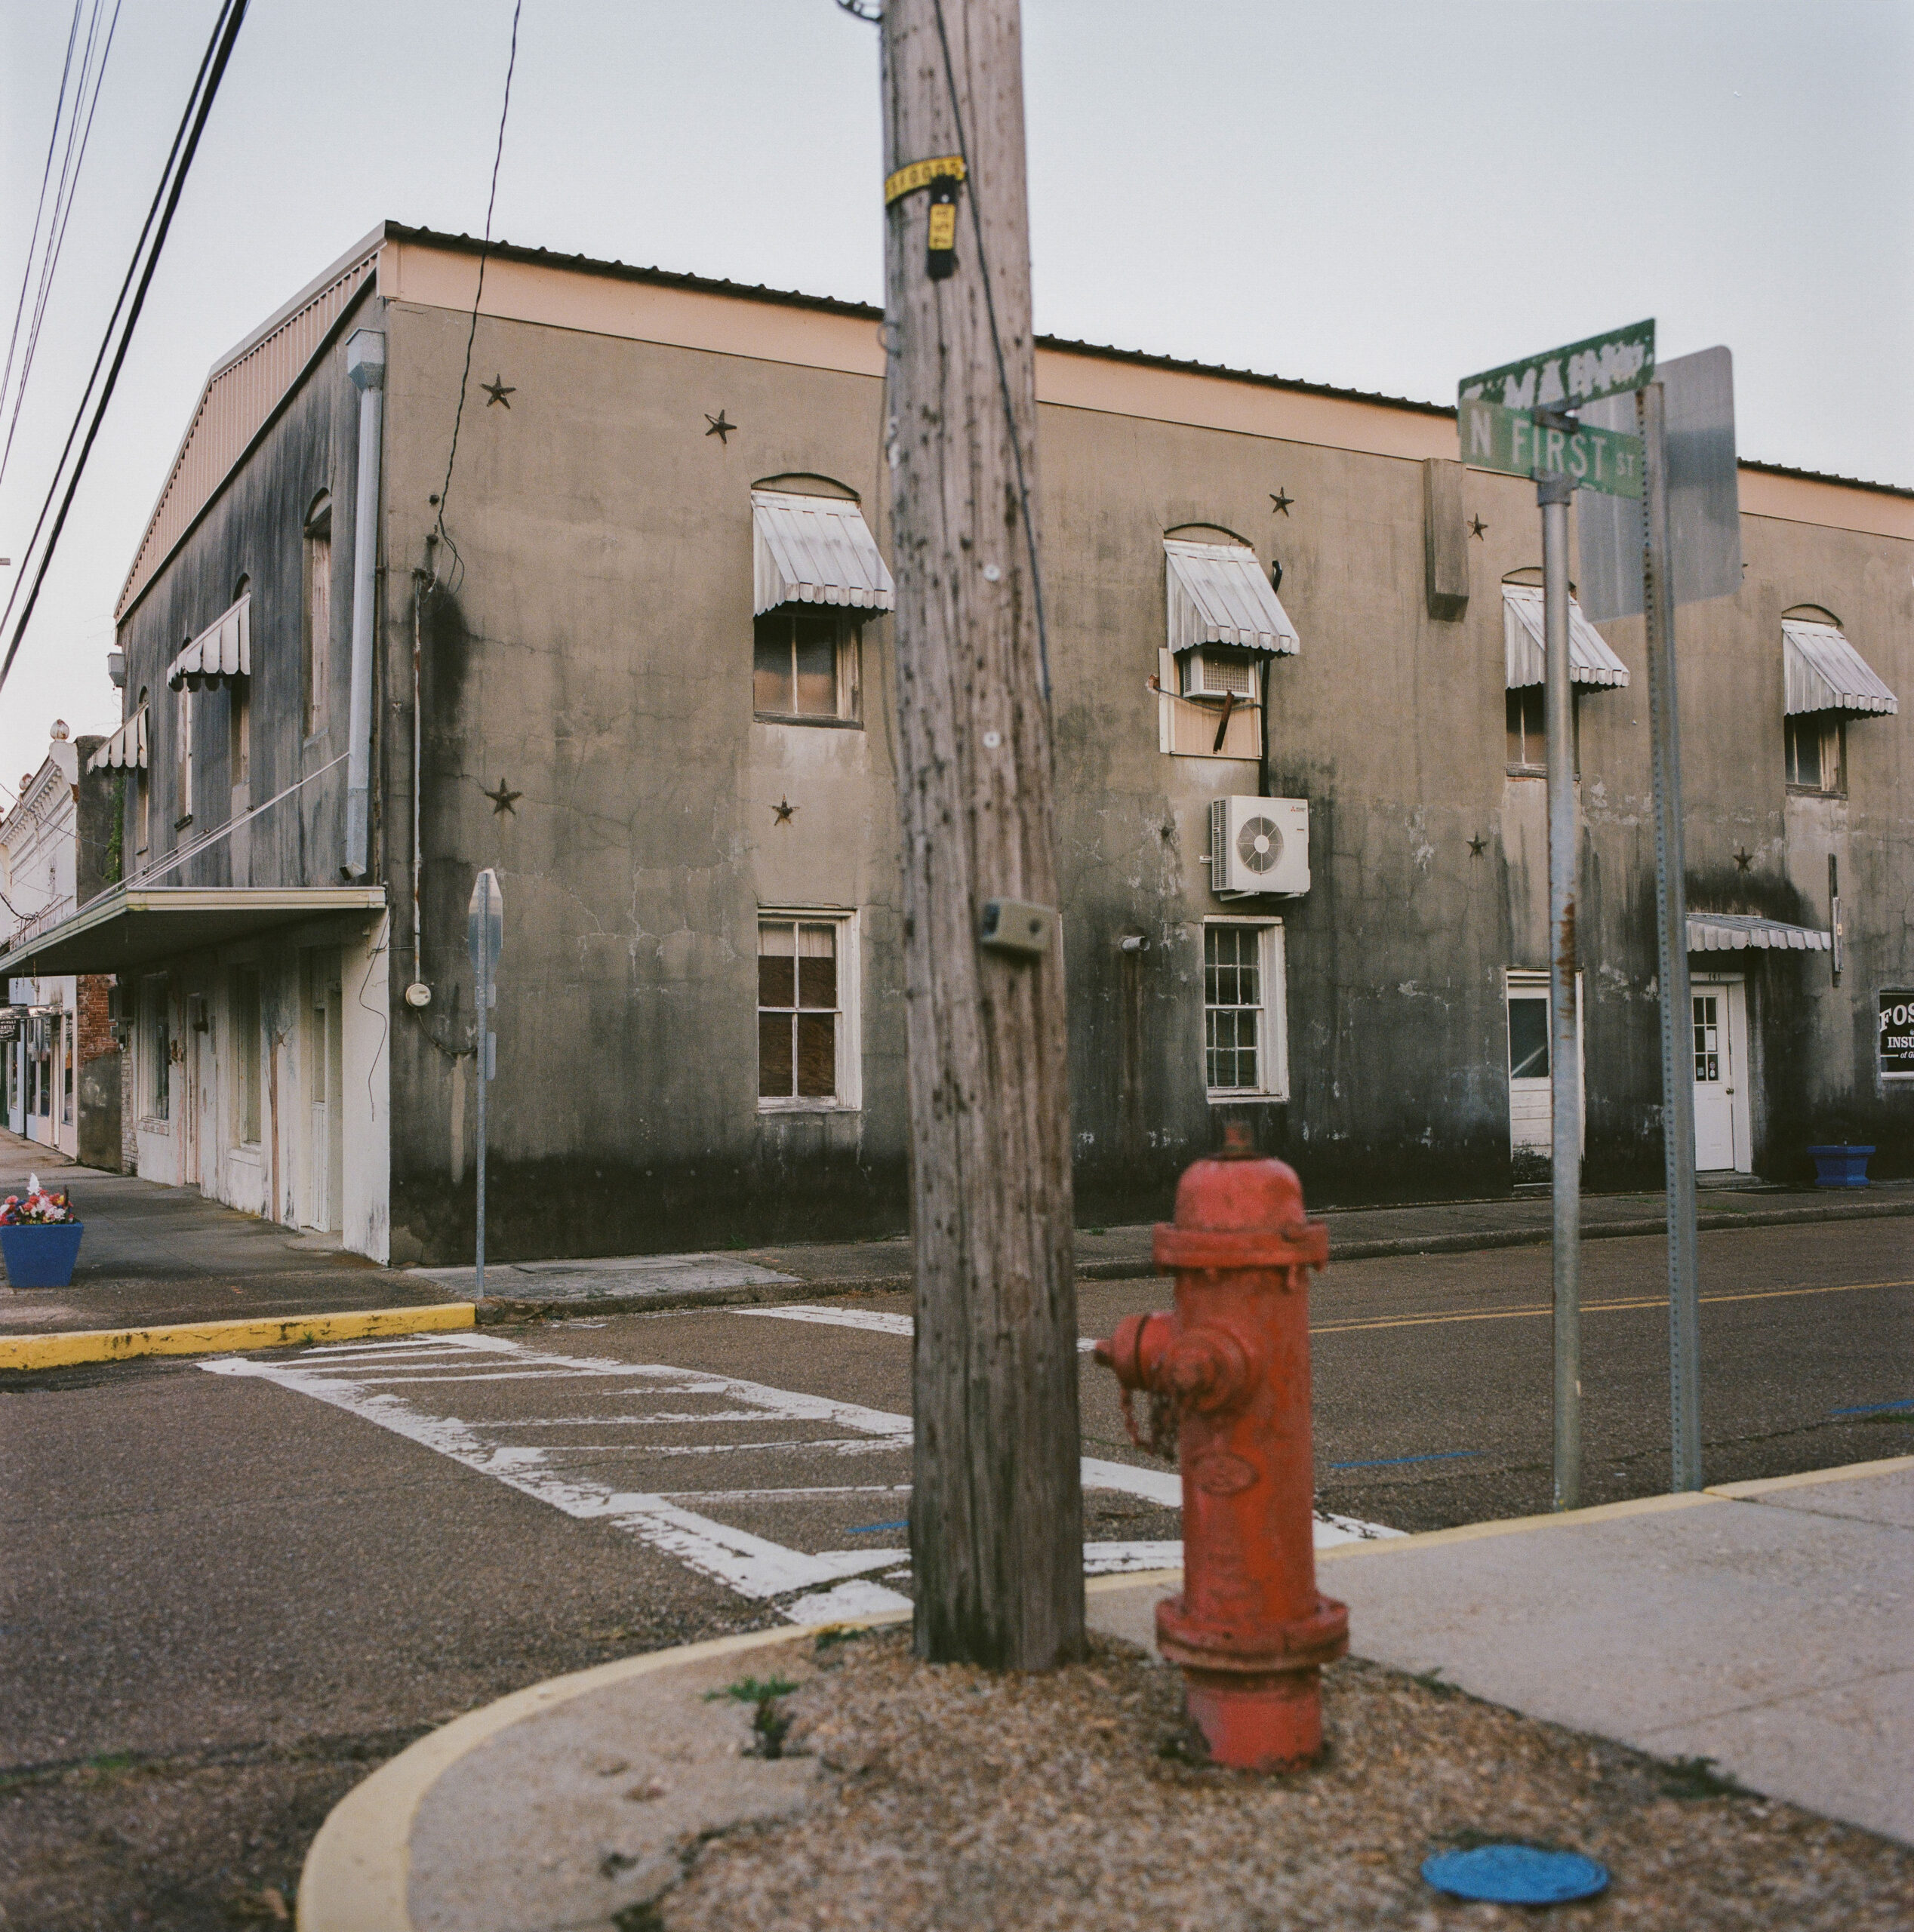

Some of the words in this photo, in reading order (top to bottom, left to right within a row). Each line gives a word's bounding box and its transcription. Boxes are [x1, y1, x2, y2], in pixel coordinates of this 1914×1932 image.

[1469, 408, 1492, 458] N
[1511, 417, 1608, 481] FIRST
[1615, 454, 1635, 478] ST
